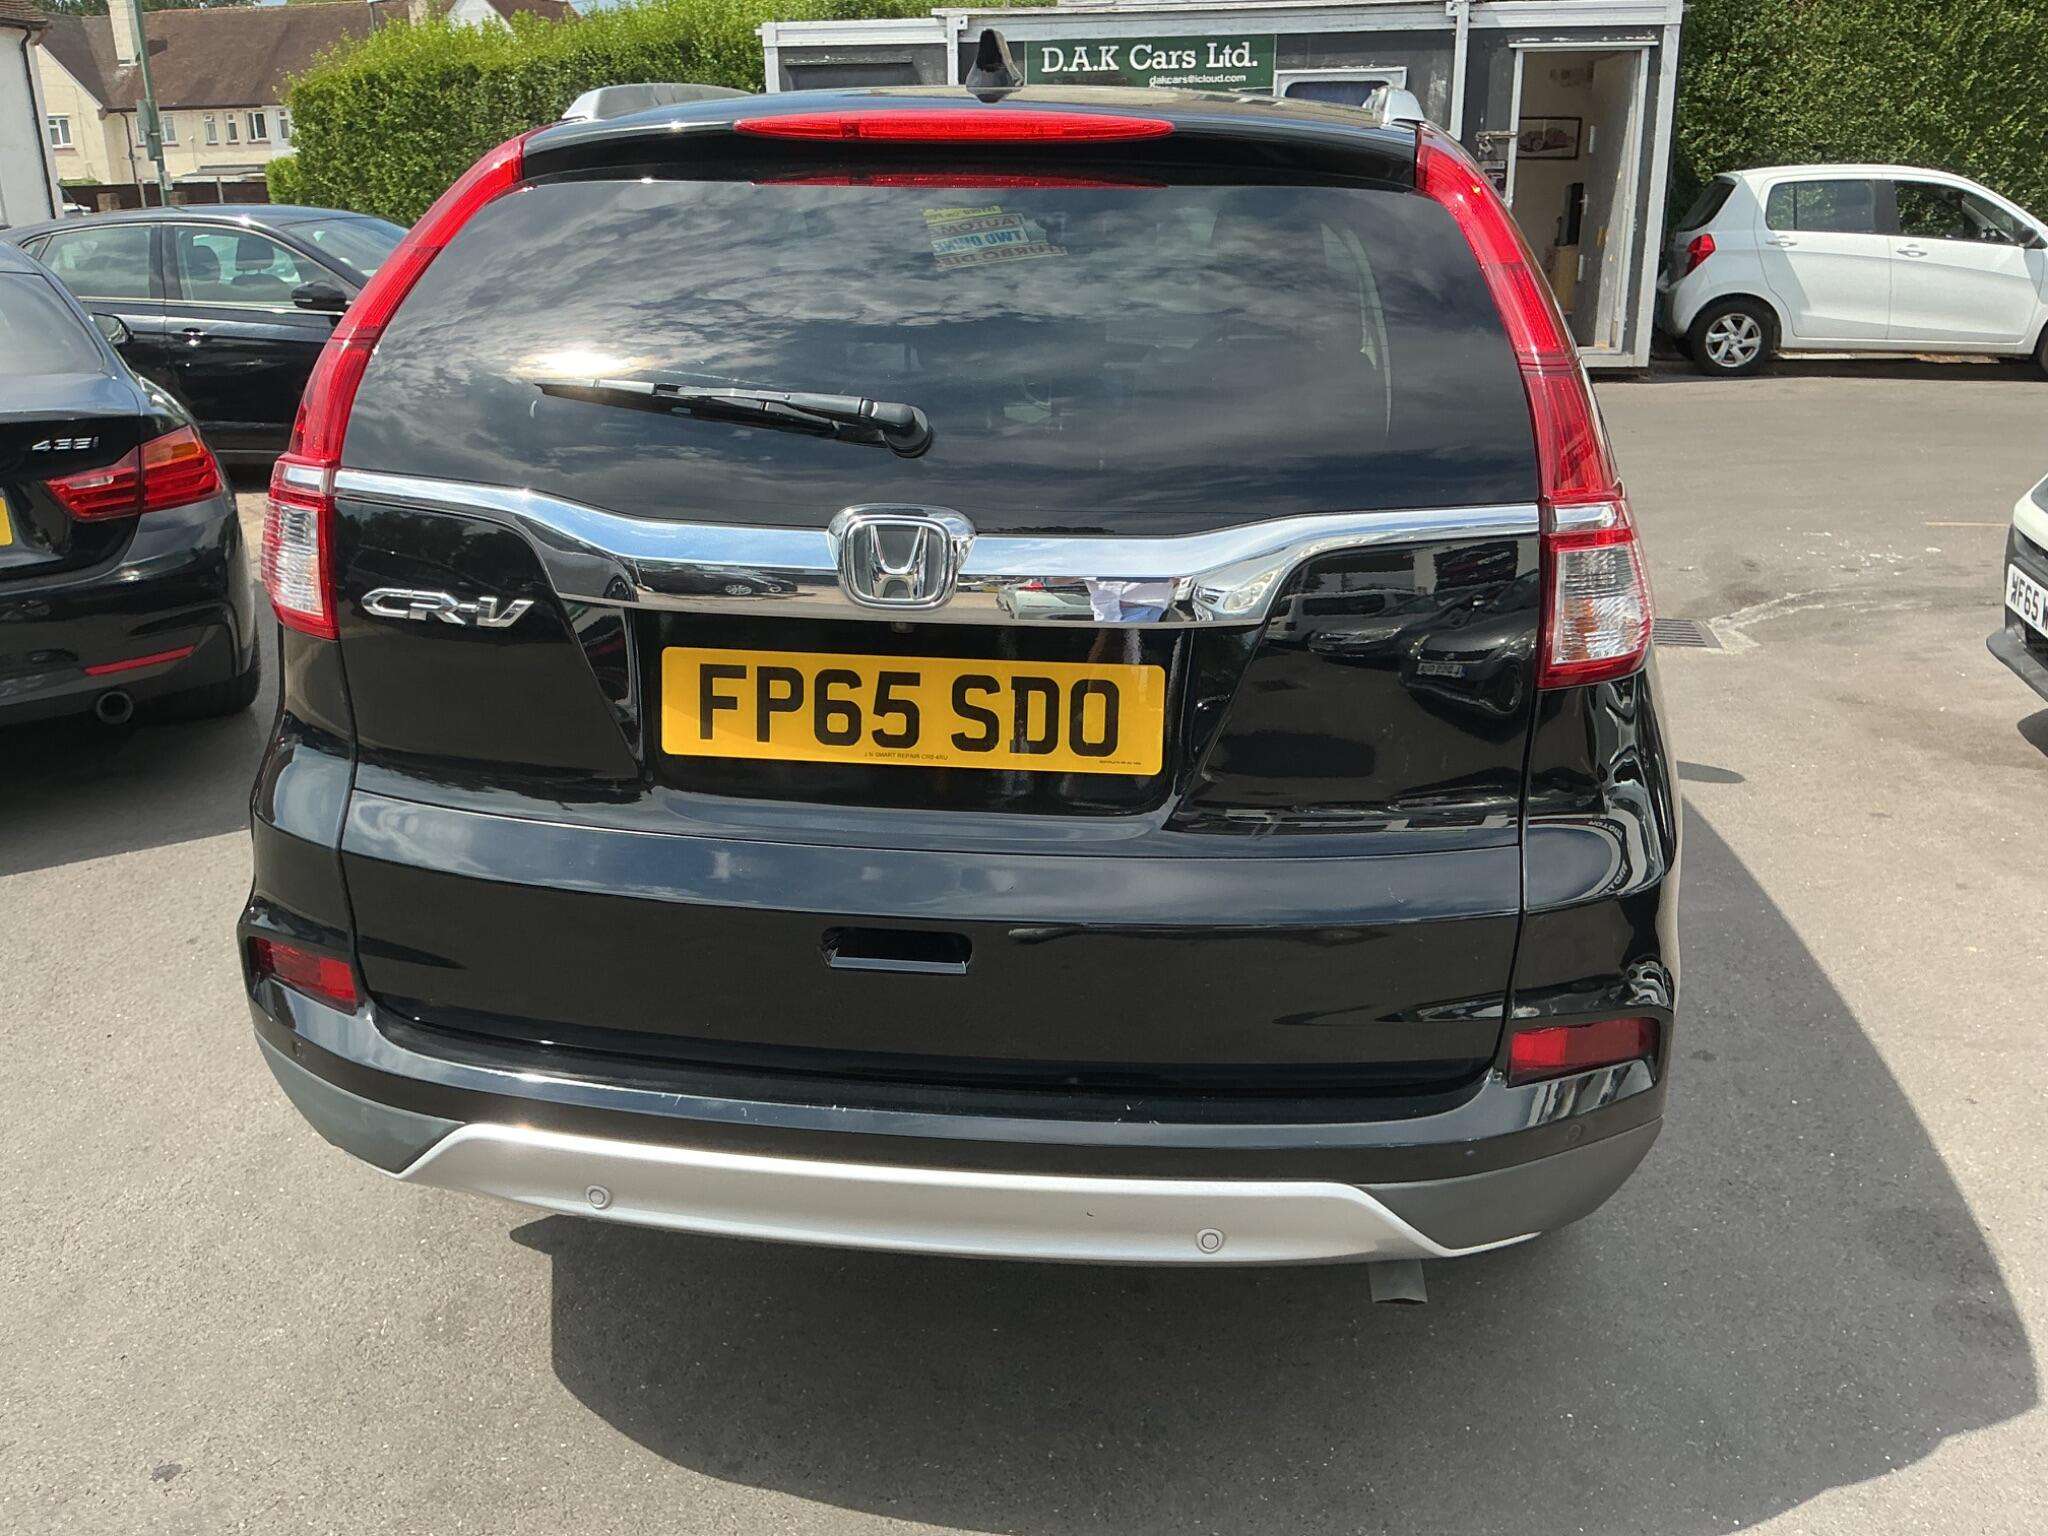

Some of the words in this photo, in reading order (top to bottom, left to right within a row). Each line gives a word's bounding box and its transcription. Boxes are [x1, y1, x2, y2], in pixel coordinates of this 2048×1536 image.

[1041, 45, 1119, 72] D.A.K
[1129, 44, 1196, 70] Cars
[1206, 42, 1258, 68] Ltd.
[1149, 74, 1246, 85] dakcars@icloud.com
[361, 588, 534, 627] CR-V
[700, 663, 920, 748] FP65
[951, 674, 1120, 757] SDO
